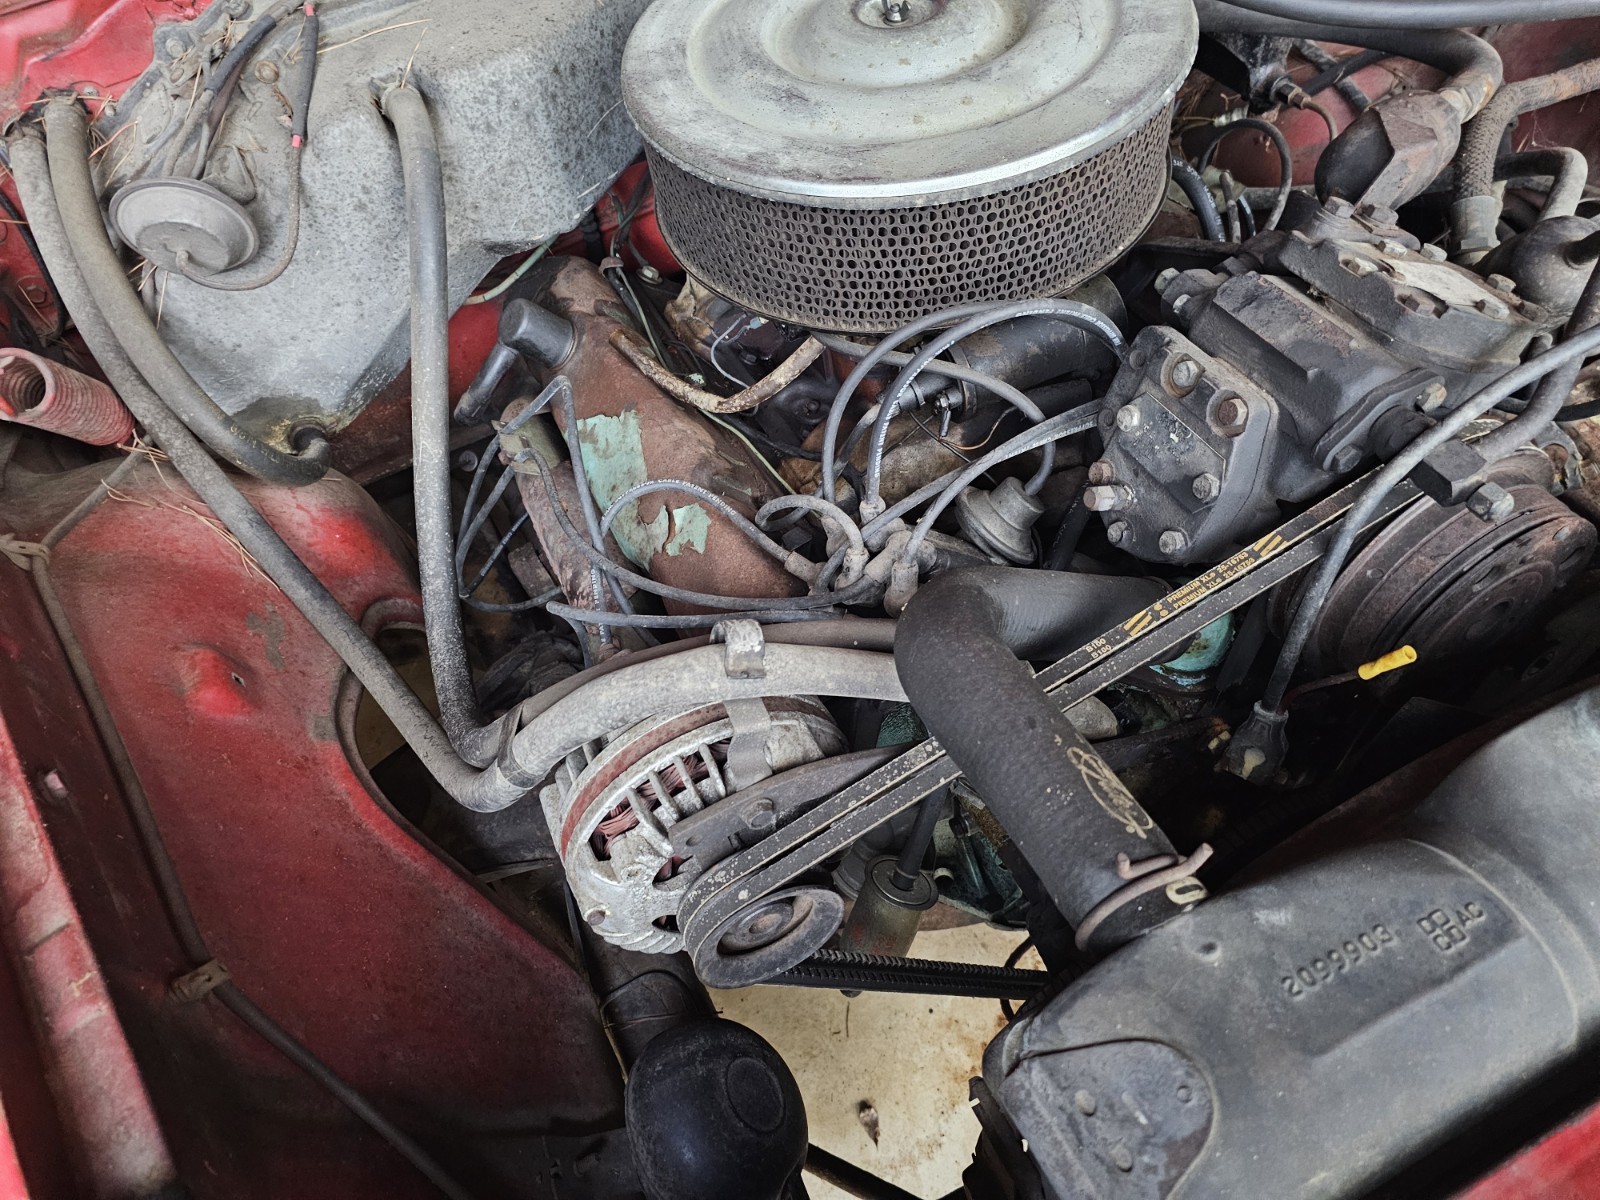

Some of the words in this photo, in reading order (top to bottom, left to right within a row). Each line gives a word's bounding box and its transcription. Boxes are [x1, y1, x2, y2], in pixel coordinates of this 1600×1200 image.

[872, 446, 883, 478] PENDING
[681, 479, 707, 495] PATENT
[707, 491, 736, 517] PENDING
[590, 568, 600, 605] PENDING
[1167, 581, 1202, 603] PREMIUM
[1173, 587, 1208, 610] PREMIUM
[1455, 901, 1485, 928] AC
[1280, 923, 1394, 997] 2099903
